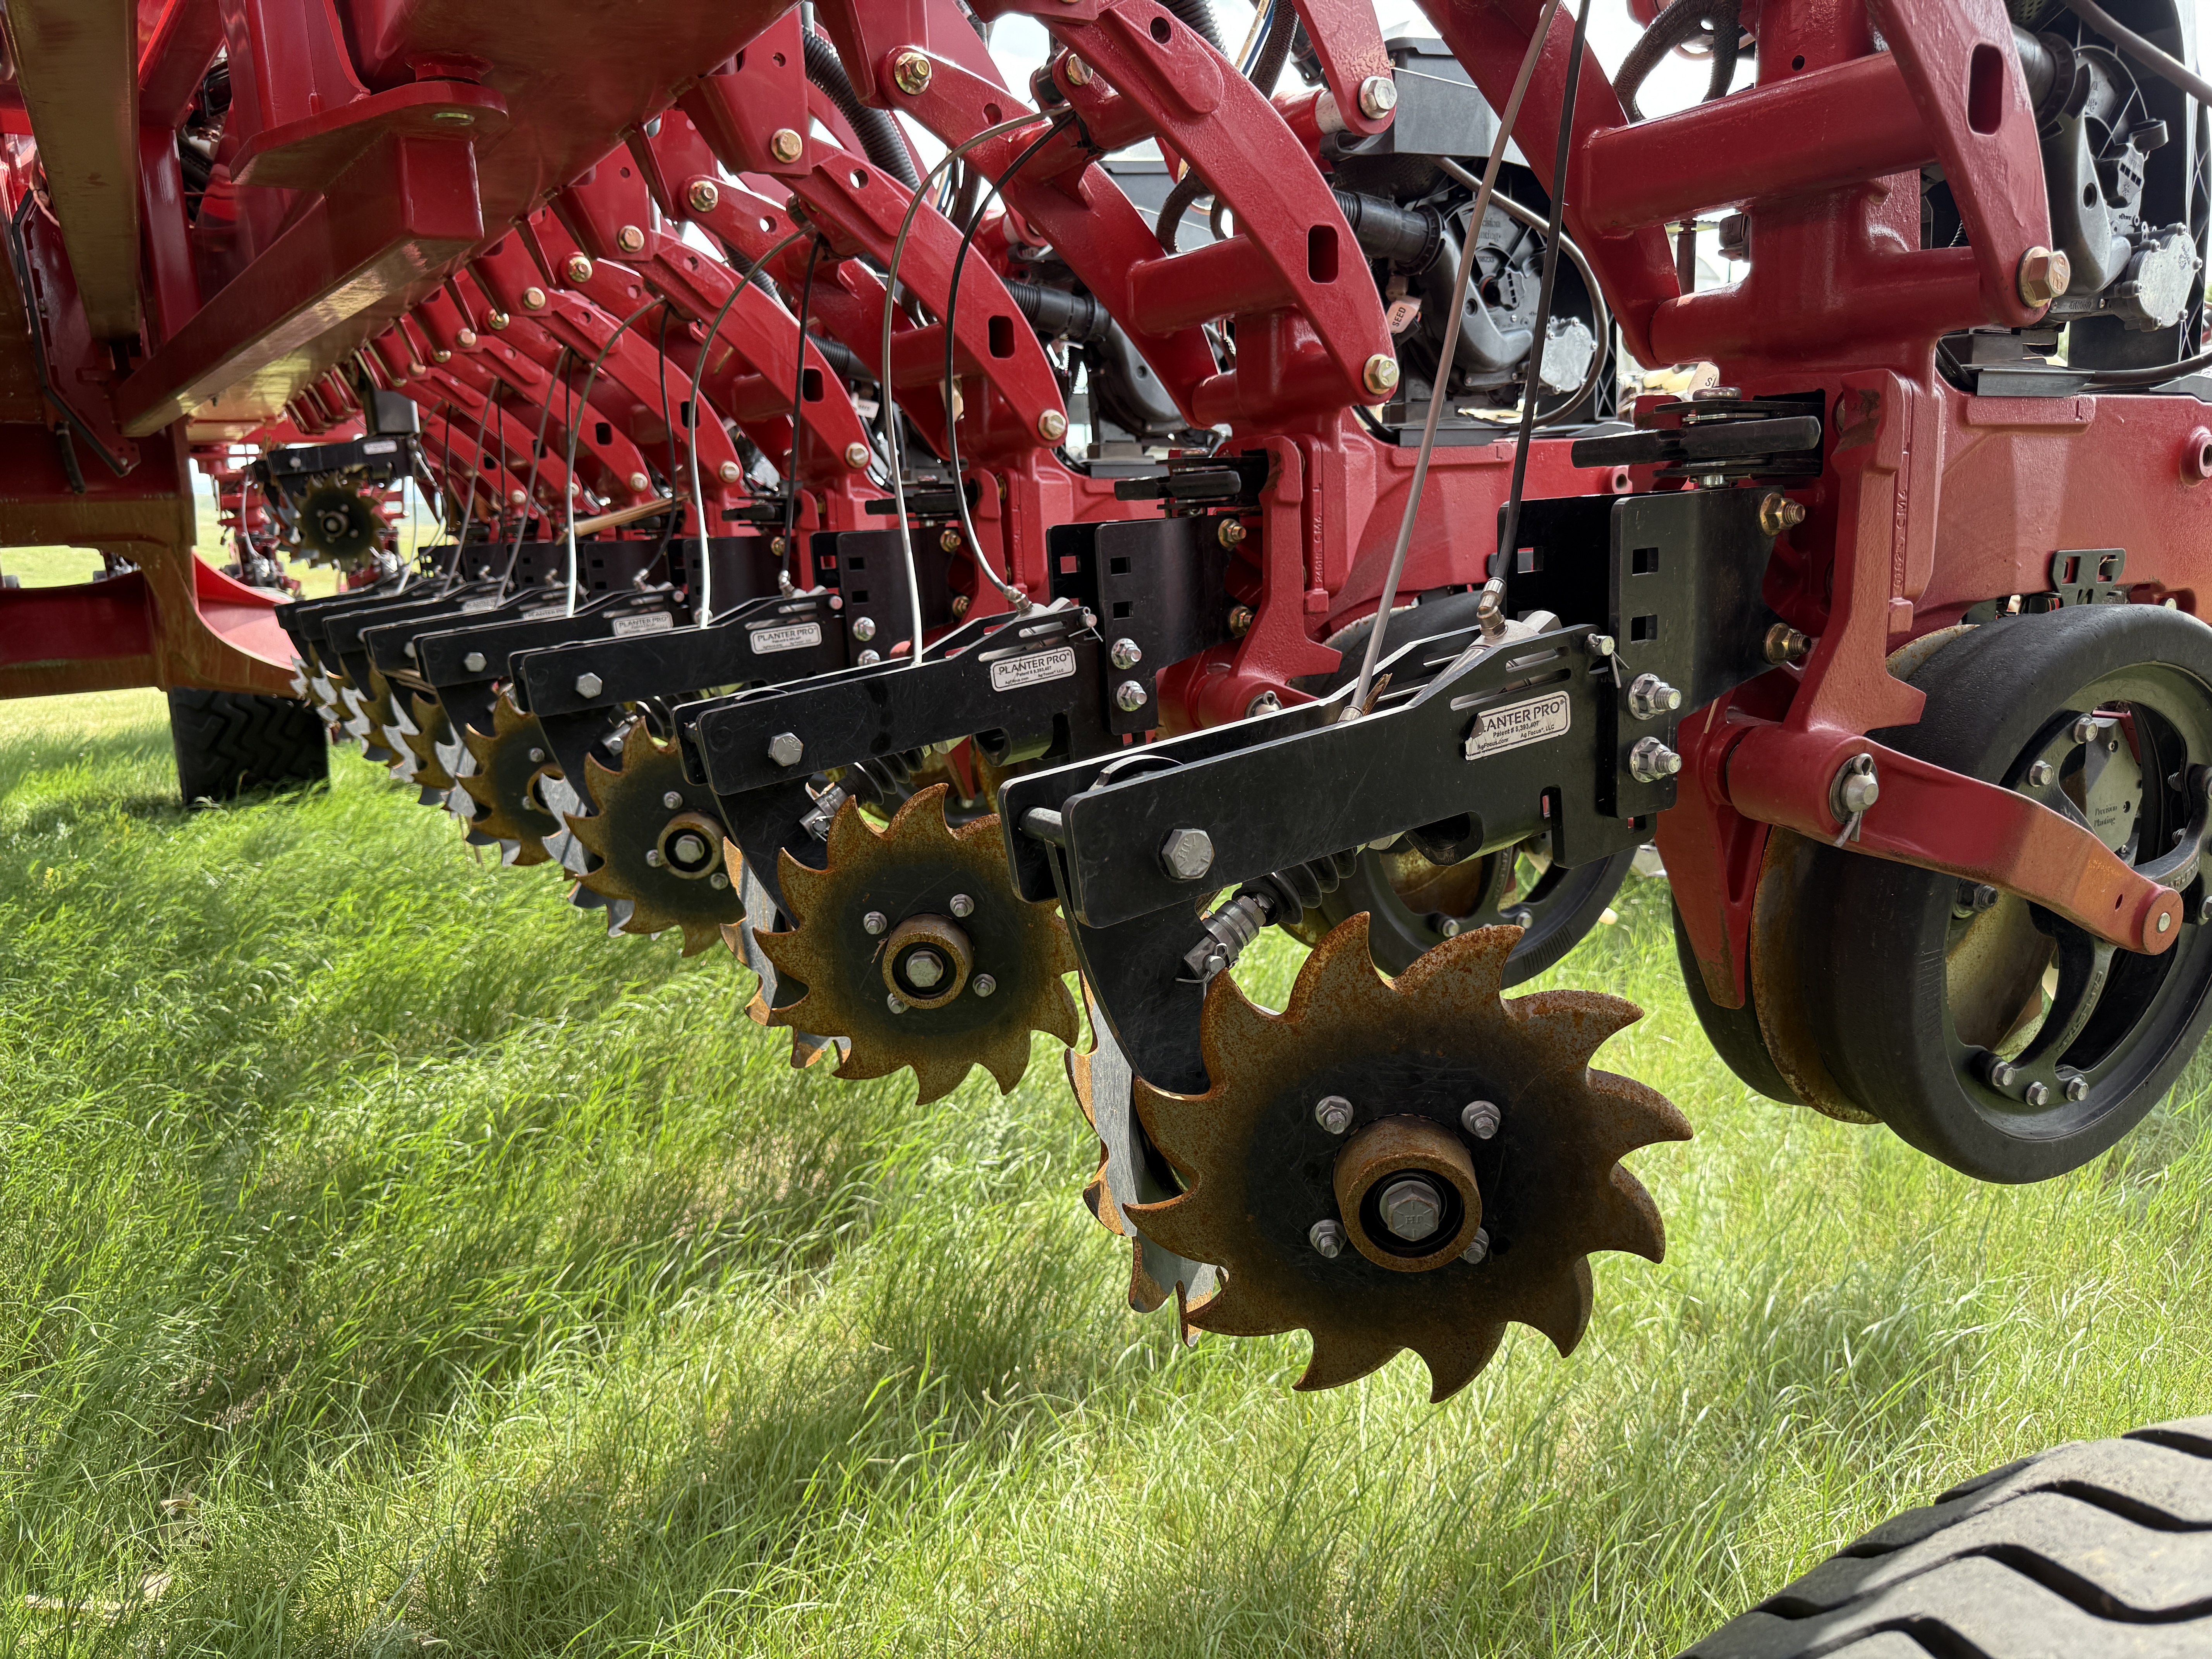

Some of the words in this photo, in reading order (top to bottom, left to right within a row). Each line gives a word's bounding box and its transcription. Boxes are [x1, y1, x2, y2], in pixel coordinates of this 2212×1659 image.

[1392, 307, 1406, 327] SEED
[619, 618, 651, 627] PLANTER
[758, 630, 796, 642] PLANTER
[797, 628, 814, 637] PRO
[999, 659, 1045, 675] PLANTER
[1484, 708, 1531, 732] ANTER
[1493, 728, 1510, 738] Patent
[1515, 720, 1539, 733] 8,393,407
[1477, 737, 1509, 750] AgFocus.com
[2095, 805, 2117, 816] Precision
